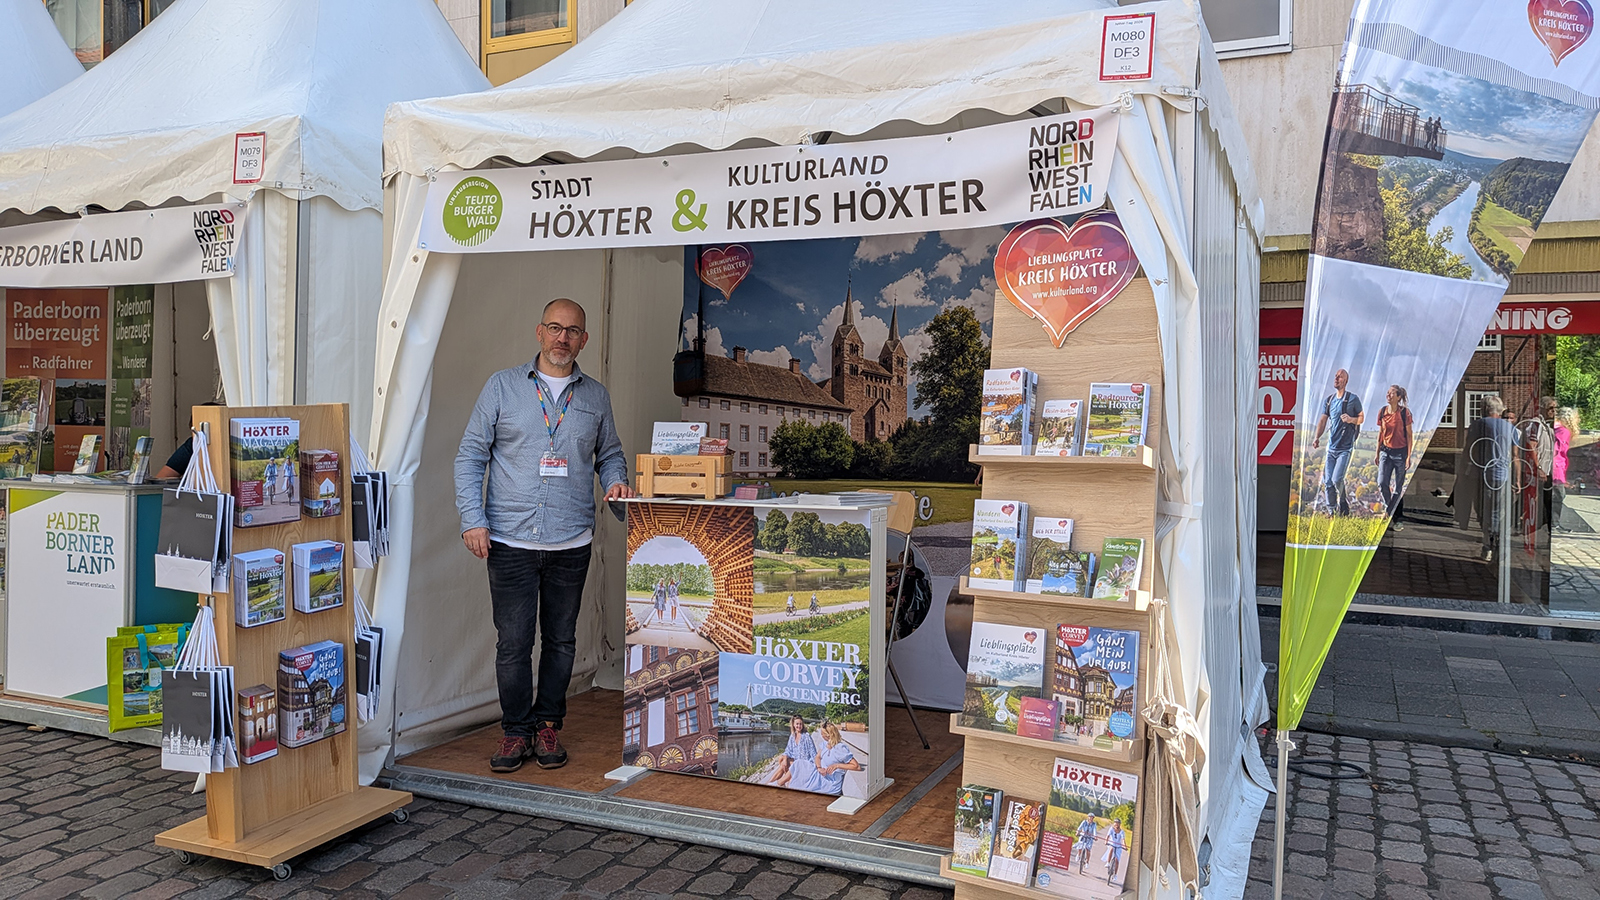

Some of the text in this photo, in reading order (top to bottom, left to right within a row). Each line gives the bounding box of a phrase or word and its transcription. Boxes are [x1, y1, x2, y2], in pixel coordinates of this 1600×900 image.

[1543, 9, 1579, 21] LIEBLINGSPLATZ
[1539, 17, 1585, 33] KREIS HÖXTER
[1111, 30, 1145, 41] M080
[1114, 47, 1140, 58] DF3
[1029, 118, 1094, 148] NORD
[240, 147, 261, 156] M079
[1028, 140, 1094, 170] RHEIN
[242, 159, 258, 168] DF3
[728, 155, 889, 187] KULTURLAND
[1028, 162, 1093, 192] WEST
[449, 181, 489, 206] URLAUBSREGION
[531, 177, 593, 200] STADT
[465, 195, 498, 205] TEUTO
[726, 180, 987, 230] KREIS HÖXTER
[1030, 184, 1093, 213] FALEN
[194, 210, 235, 228] NORD
[454, 206, 494, 216] BURGER
[671, 189, 708, 232] &
[466, 216, 498, 228] WALD
[529, 204, 653, 239] HÖXTER
[194, 225, 235, 243] RHEIN
[90, 237, 143, 263] LAND
[200, 241, 234, 258] WEST
[1028, 248, 1104, 267] LIEBLINGSPLATZ
[201, 257, 234, 273] FALEN
[706, 265, 722, 277] KREIS
[1018, 260, 1117, 287] KREIS HÖXTER
[1032, 285, 1098, 299] www.kulturland.org
[13, 300, 100, 319] Paderborn
[116, 296, 152, 318] Paderborn
[14, 322, 100, 347] überzeugt
[116, 322, 151, 344] überzeugt
[32, 356, 93, 370] Radfahrer
[122, 355, 148, 369] Wanderer
[1098, 394, 1139, 402] Radtouren
[242, 438, 291, 448] MAGAZIN
[46, 512, 100, 533] PADER
[45, 531, 115, 555] BORNER
[67, 554, 116, 575] LAND
[980, 638, 1038, 654] Lieblingsplätze
[1096, 634, 1126, 649] GANZ
[318, 650, 337, 662] GANZ
[753, 659, 862, 690] CORVEY
[752, 682, 861, 706] FÜRSTENBERG
[1053, 778, 1123, 806] MAGAZIN
